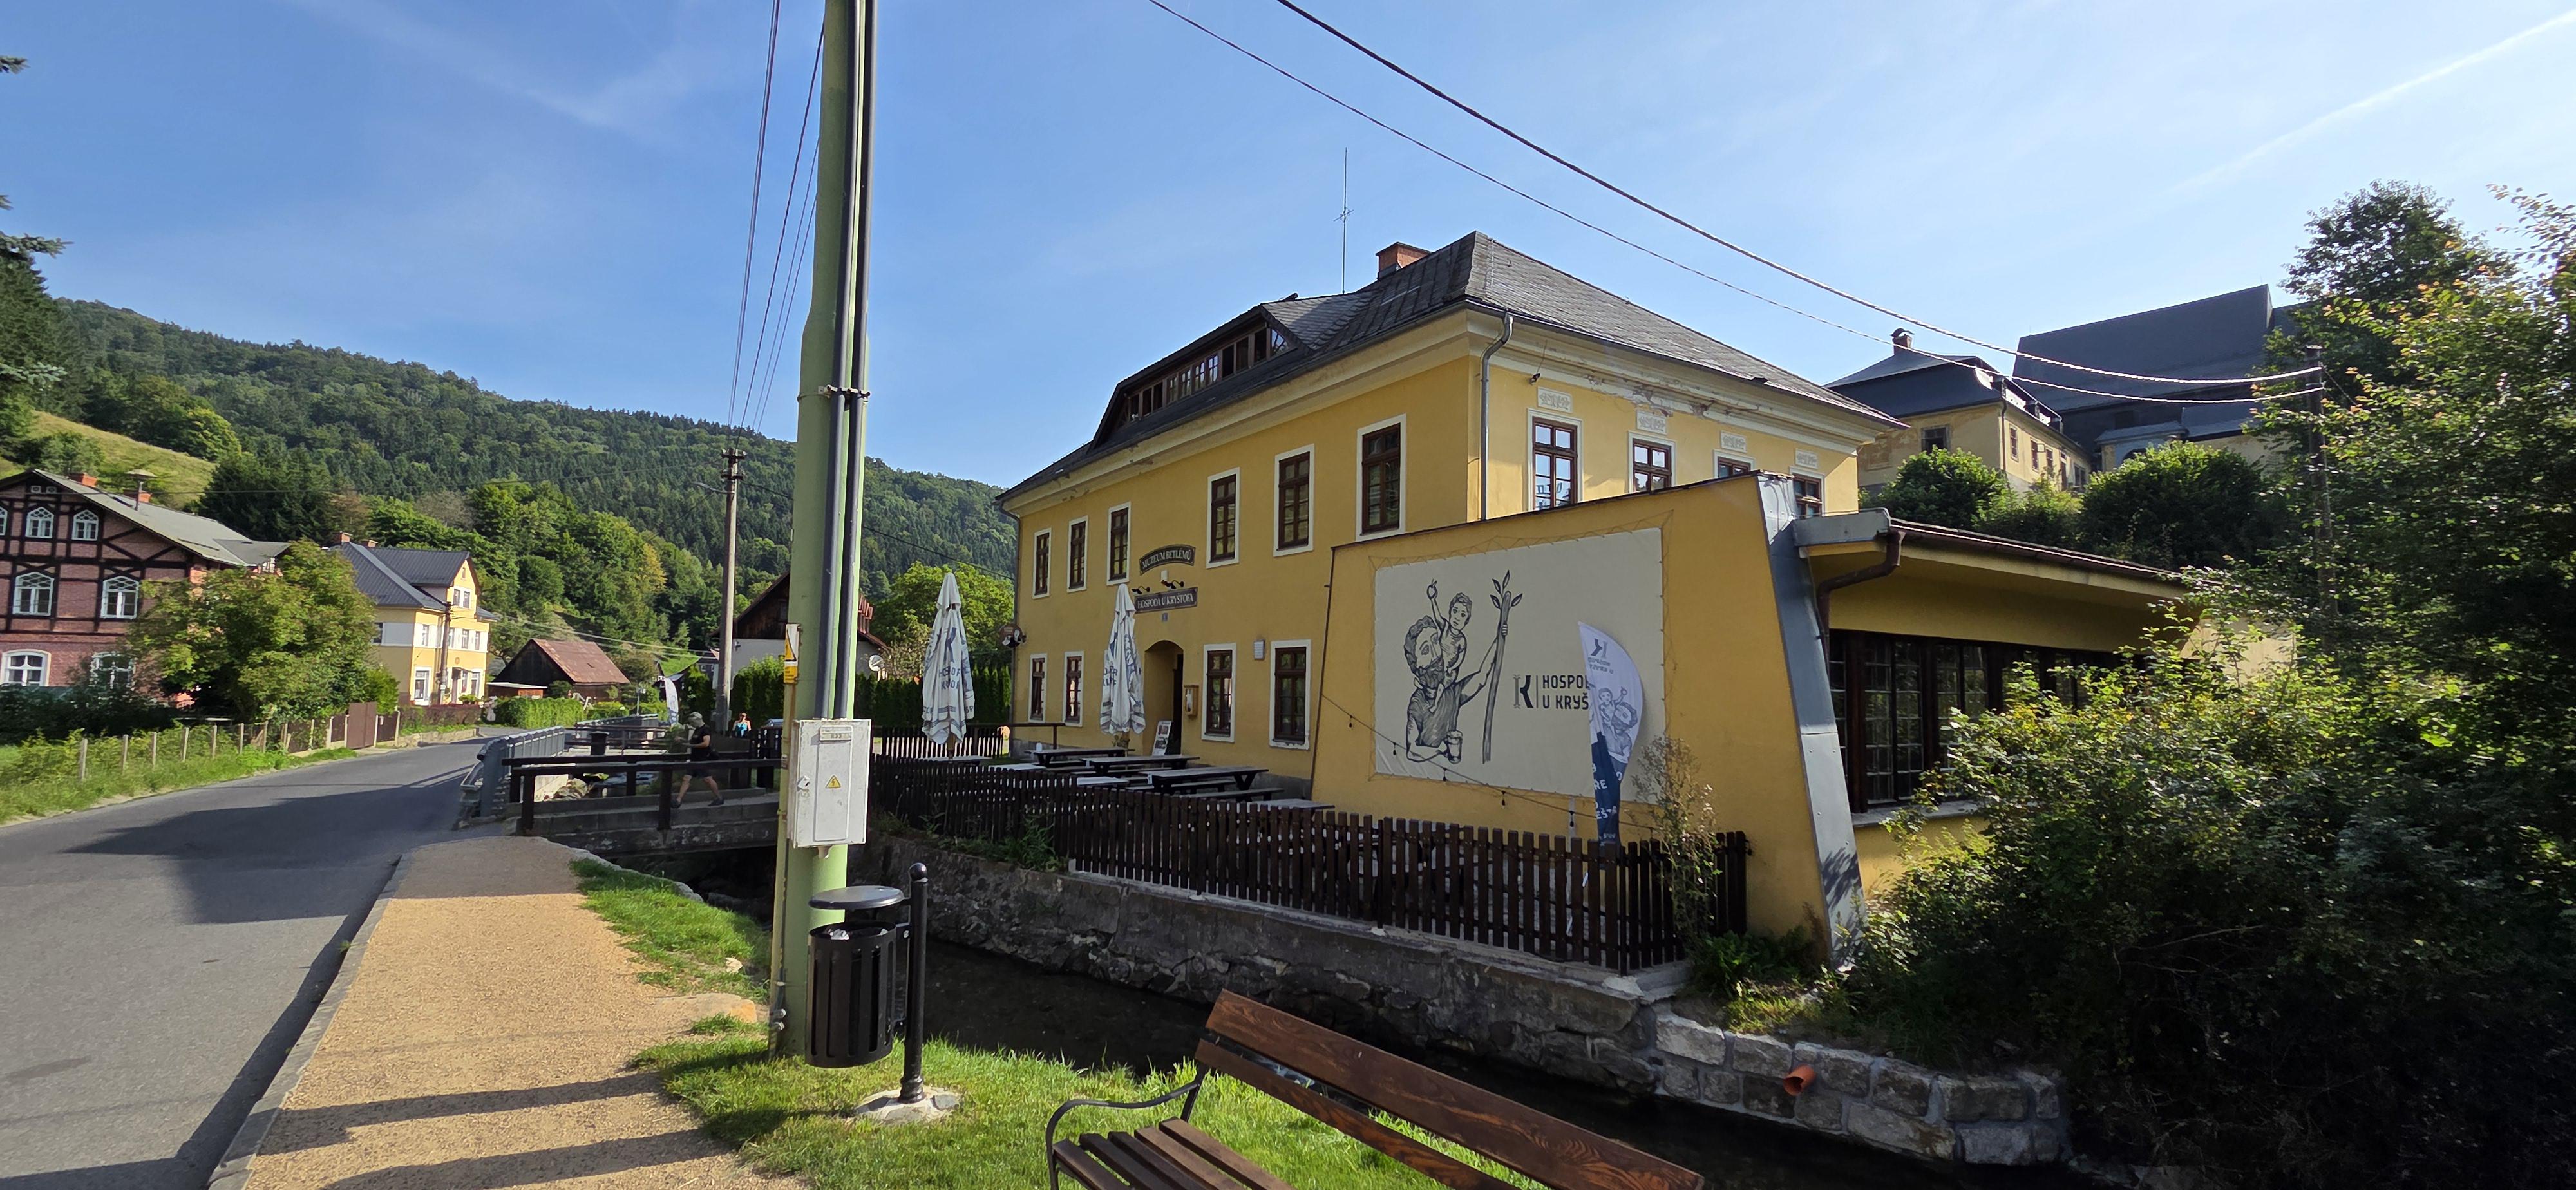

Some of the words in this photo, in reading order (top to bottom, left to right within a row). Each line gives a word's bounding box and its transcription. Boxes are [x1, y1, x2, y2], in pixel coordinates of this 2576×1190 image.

[1142, 552, 1165, 567] MUZEUM
[1137, 598, 1160, 609] HOSPODA
[1161, 596, 1166, 605] U
[1166, 593, 1194, 605] KRYŠTOFA
[1542, 675, 1587, 689] HOSPO
[1542, 695, 1550, 709] U
